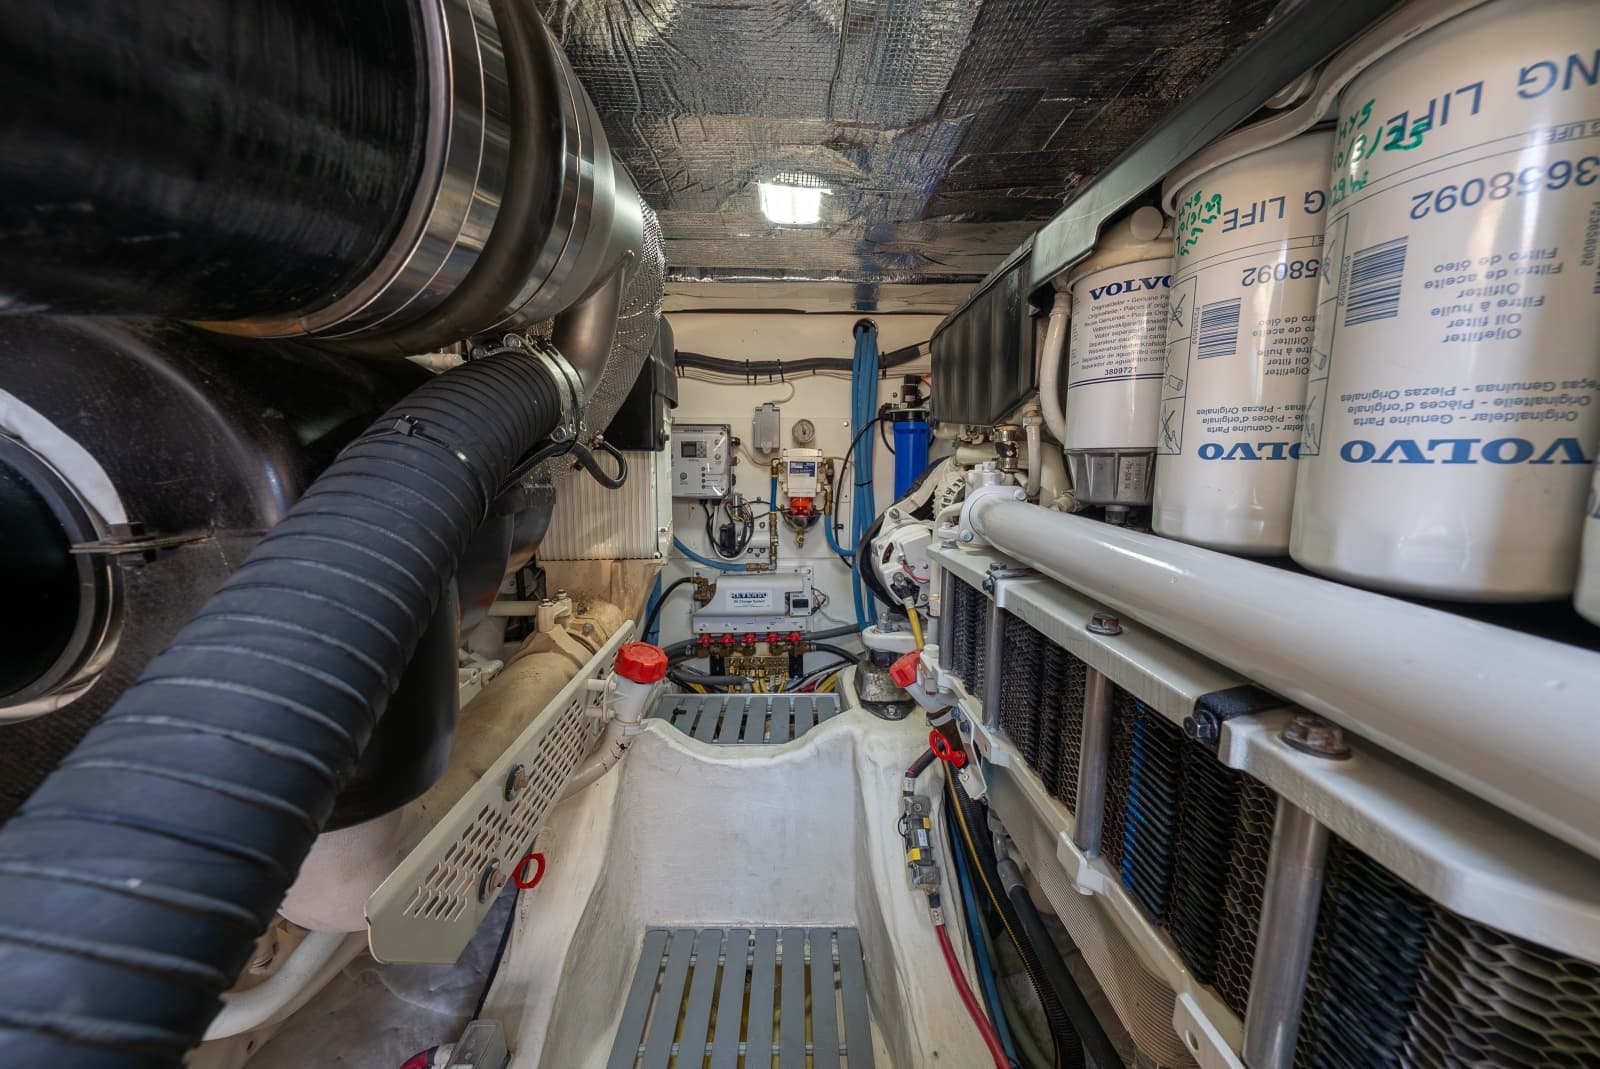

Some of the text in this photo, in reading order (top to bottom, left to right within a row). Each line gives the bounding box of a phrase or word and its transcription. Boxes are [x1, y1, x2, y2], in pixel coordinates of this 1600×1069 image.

[1386, 50, 1600, 142] NG LIFE
[1410, 155, 1600, 220] 3658092
[1221, 195, 1287, 234] LIFE
[1242, 259, 1320, 288] 58092
[1485, 268, 1508, 281] de
[1446, 312, 1522, 329] Oil filter
[1442, 327, 1522, 344] Oljefilter
[1267, 357, 1310, 367] Oil filter
[1265, 366, 1310, 377] Oljefilter
[1404, 386, 1457, 399] Piezas
[1353, 416, 1385, 427] Parts
[1389, 412, 1453, 425] Genuine
[1471, 408, 1578, 424] Originaldelar
[1197, 442, 1303, 461] OLVO
[1340, 437, 1594, 465] VOLVO
